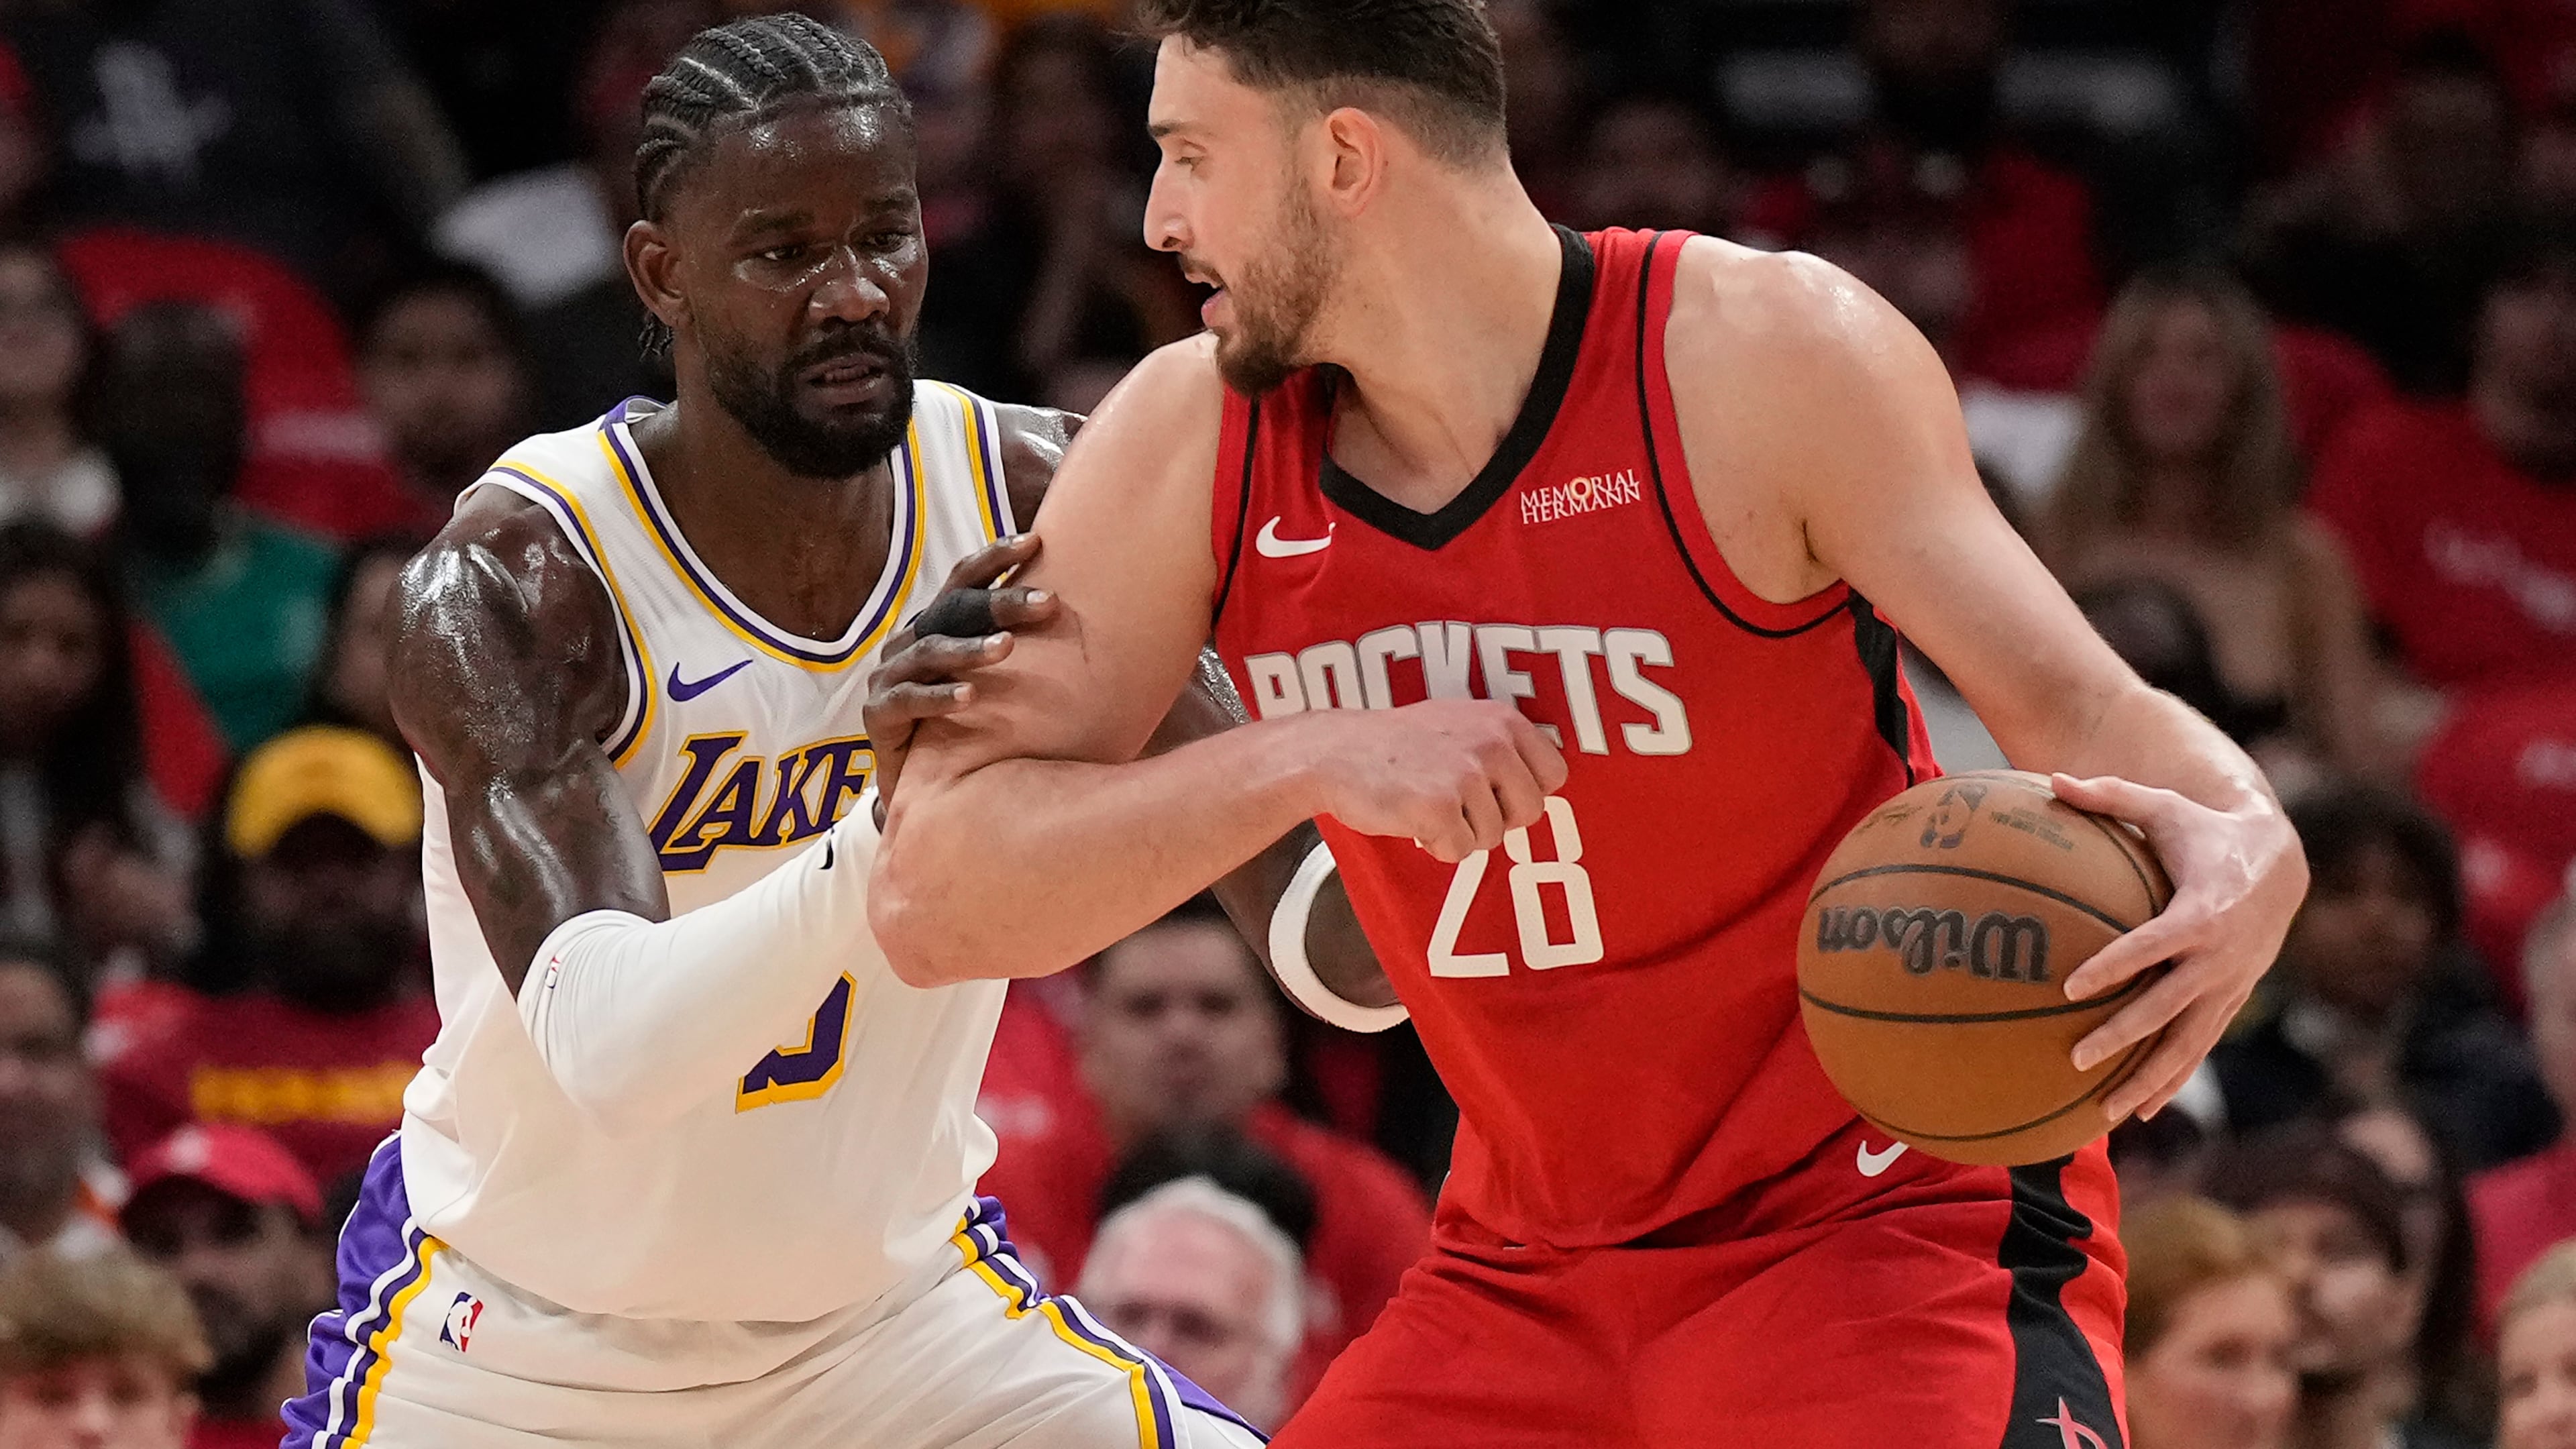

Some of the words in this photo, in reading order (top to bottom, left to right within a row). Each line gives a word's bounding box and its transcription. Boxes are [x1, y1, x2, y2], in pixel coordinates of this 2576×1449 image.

[1520, 468, 1638, 508] MEMORIAL
[1521, 482, 1641, 525] HERMANN
[646, 730, 876, 876] LAKE
[1414, 796, 1605, 978] 28
[1817, 906, 2052, 983] Wilson
